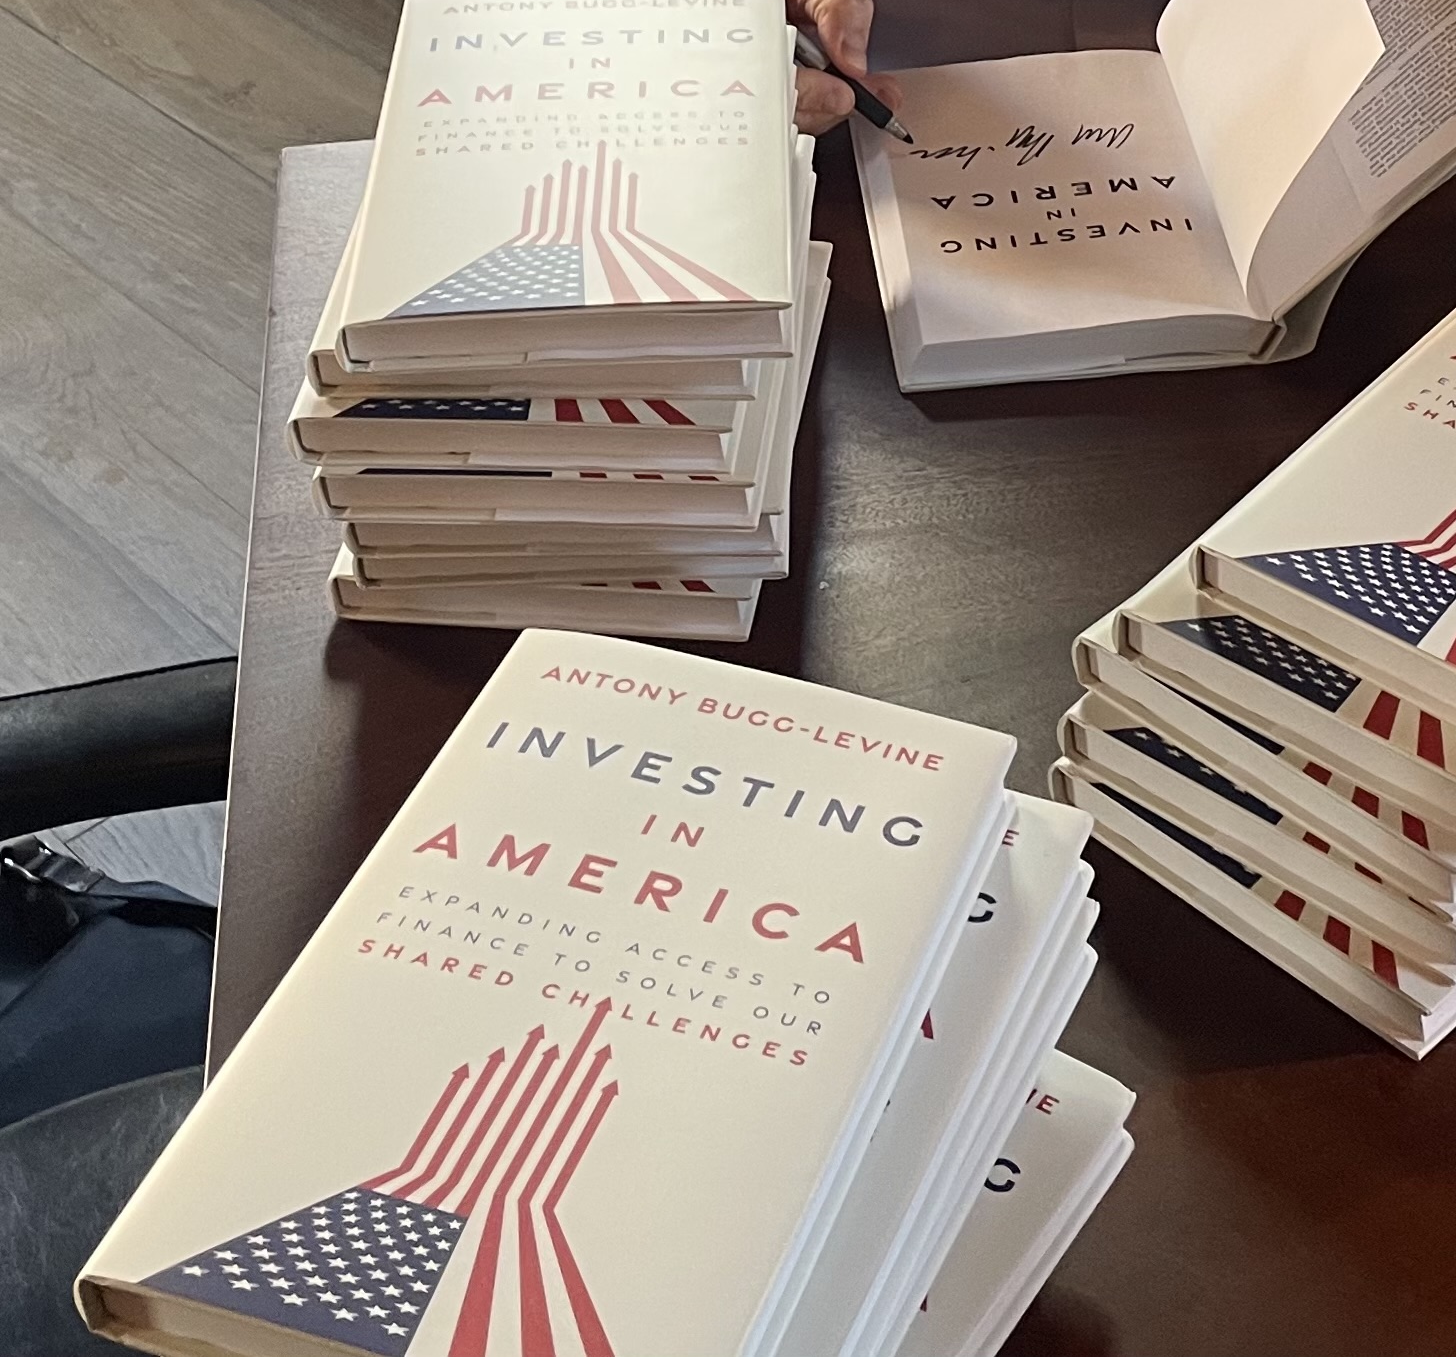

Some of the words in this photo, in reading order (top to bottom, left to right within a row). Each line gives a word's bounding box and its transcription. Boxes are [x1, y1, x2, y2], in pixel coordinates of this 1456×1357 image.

[442, 0, 552, 15] ANTONY
[430, 28, 754, 52] INVESTING
[569, 57, 611, 69] IN
[417, 80, 756, 107] AMERICA
[416, 142, 534, 156] SHARED
[930, 176, 1176, 209] AMERICA
[1046, 207, 1076, 220] IN
[940, 218, 1194, 253] INVESTING
[540, 664, 687, 707] ANTONY
[697, 696, 945, 773] BUGG-LEVINE
[486, 721, 926, 848] INVESTING
[640, 814, 705, 847] IN
[413, 823, 867, 963] AMERICA
[399, 885, 601, 944] EXPANDING
[625, 942, 764, 987] ACCESS
[792, 983, 830, 1004] TO
[357, 938, 515, 987] SHARED
[376, 911, 529, 957] FINANCE
[554, 953, 591, 973] TO
[615, 970, 727, 1009] SOLVE
[752, 1006, 823, 1036] OUR
